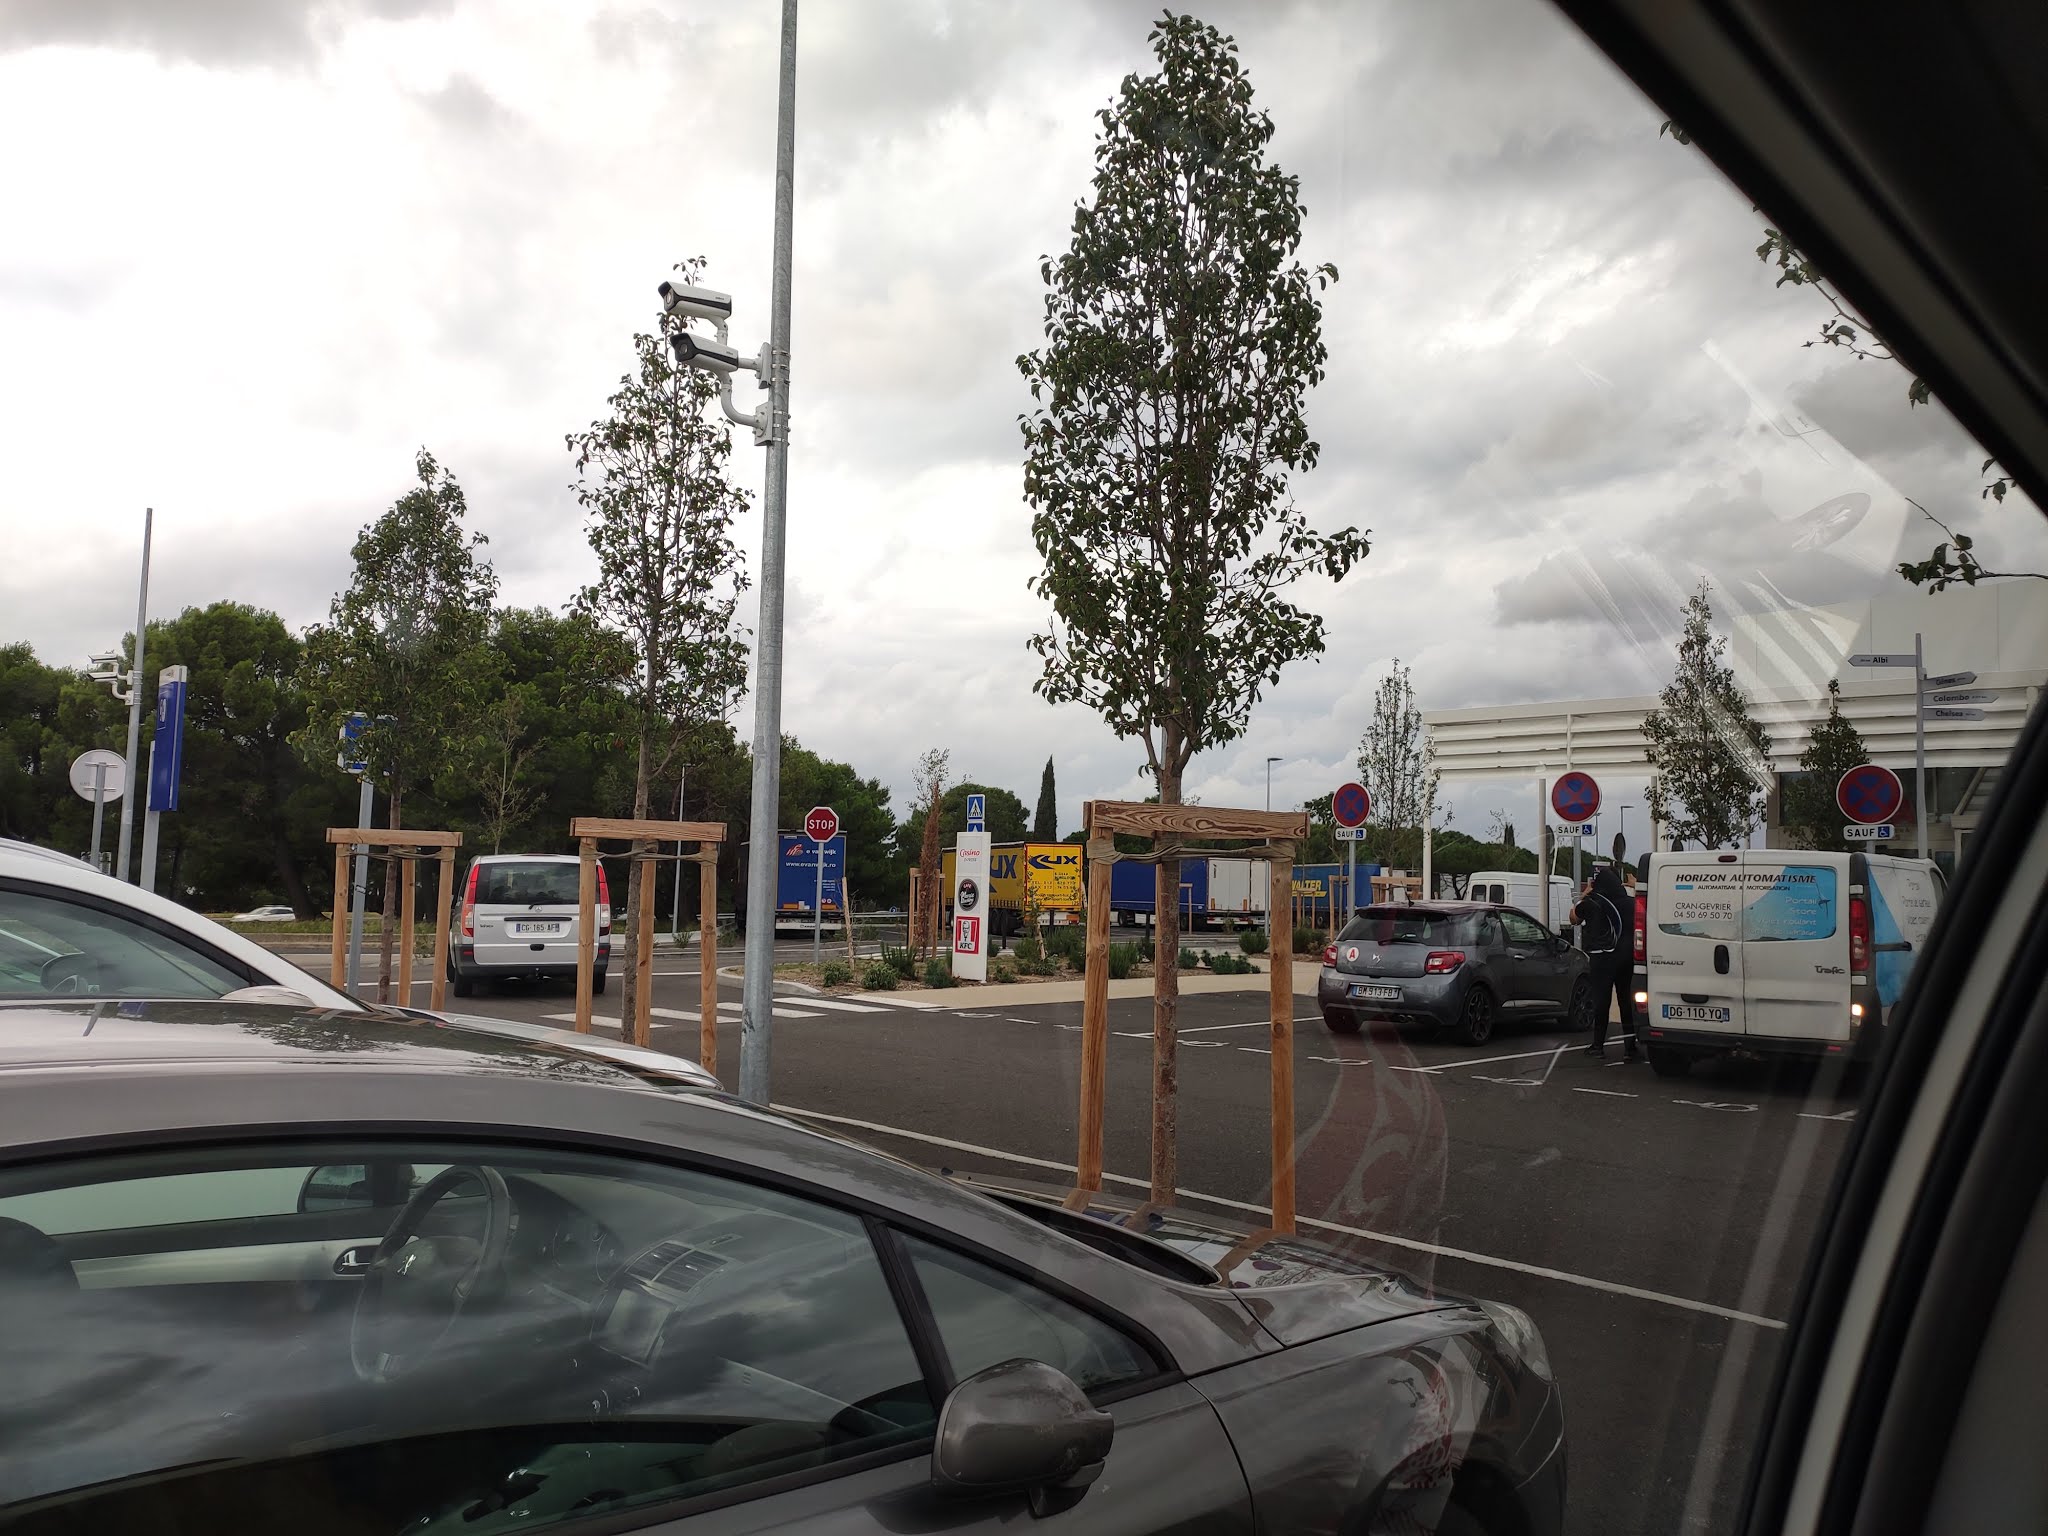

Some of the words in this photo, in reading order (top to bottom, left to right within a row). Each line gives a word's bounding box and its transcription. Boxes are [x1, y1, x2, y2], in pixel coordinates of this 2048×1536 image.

[1933, 694, 1970, 703] Colombo
[1935, 710, 1963, 718] Chelsea
[808, 819, 835, 831] STOP
[1558, 826, 1580, 834] SAUF
[1846, 828, 1876, 837] SAUF
[1675, 873, 1727, 882] HORIZON
[1729, 873, 1817, 884] AUTOMATISME
[1722, 912, 1733, 920] 70
[959, 942, 973, 950] KFC
[1349, 948, 1356, 959] A
[1815, 965, 1846, 975] Trafic
